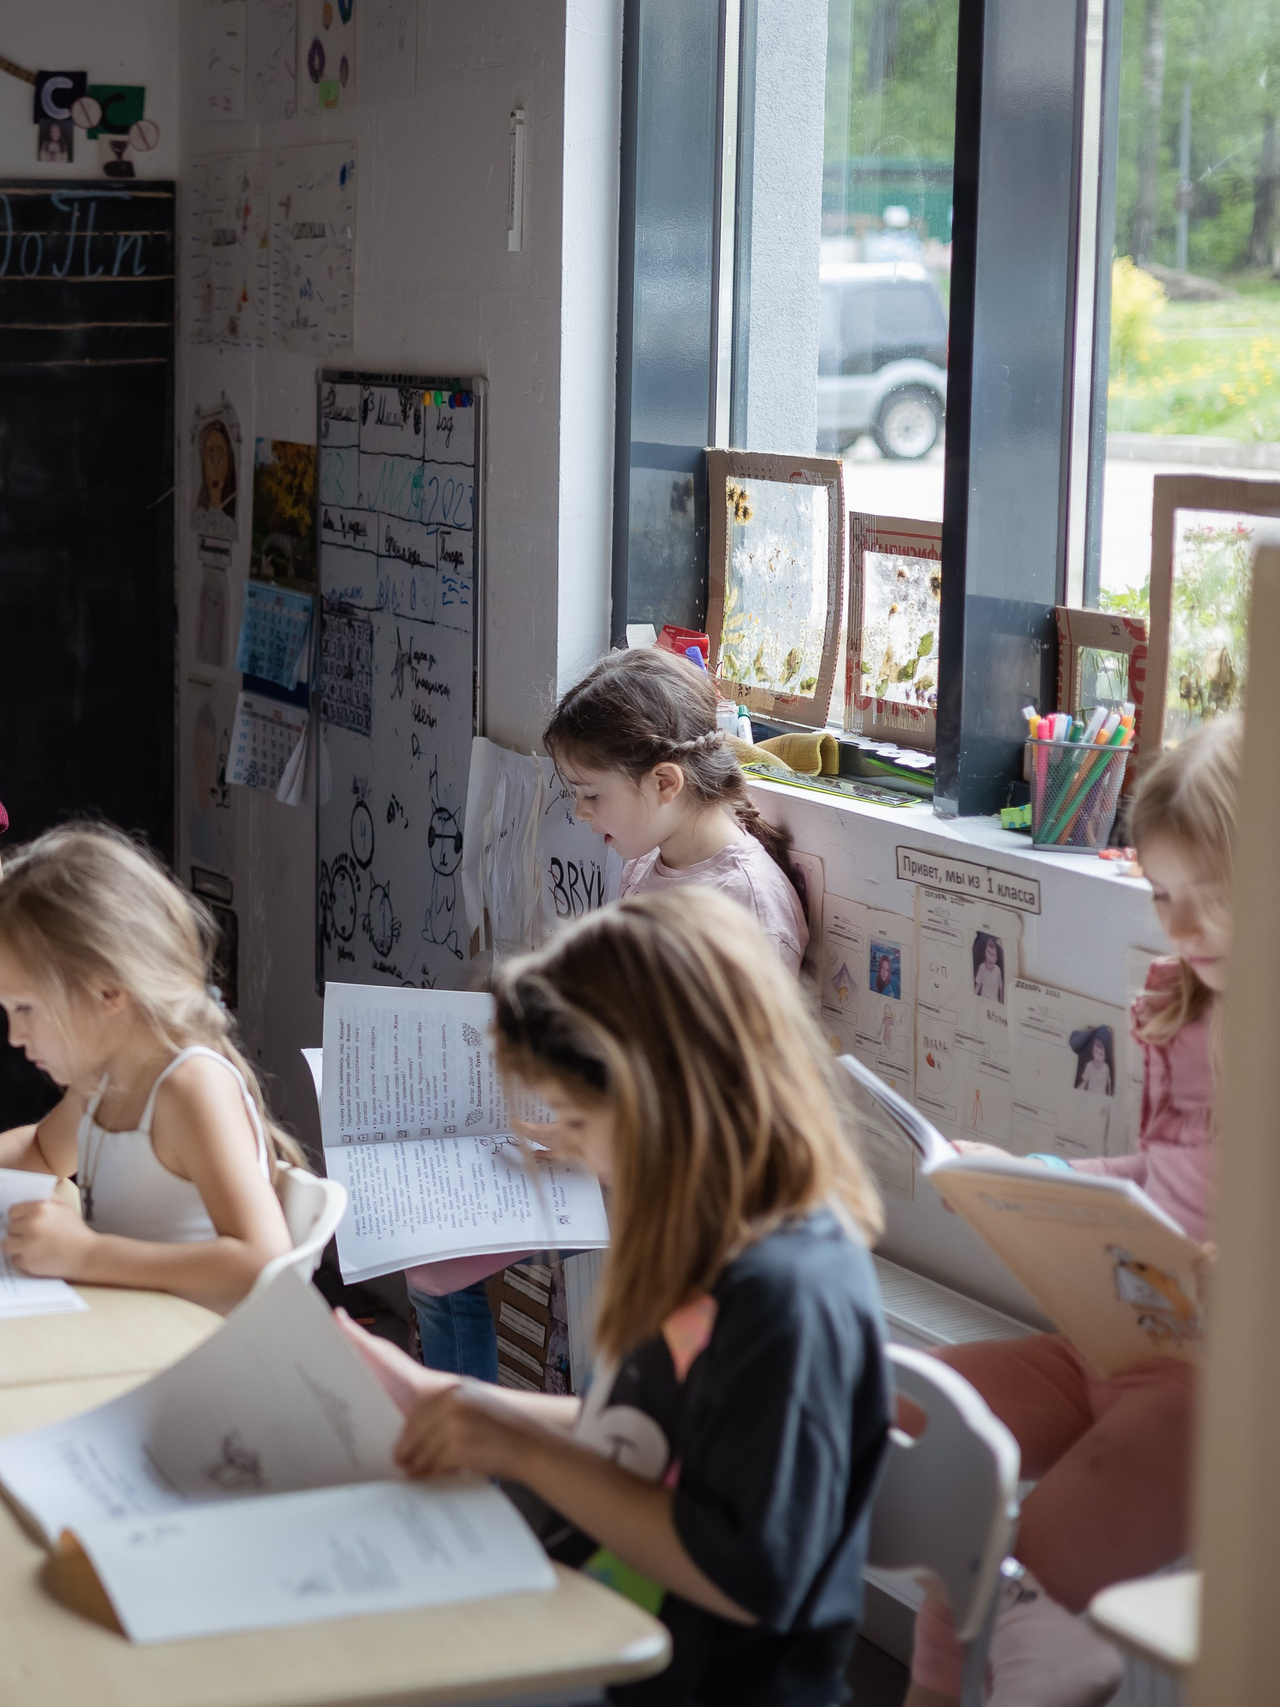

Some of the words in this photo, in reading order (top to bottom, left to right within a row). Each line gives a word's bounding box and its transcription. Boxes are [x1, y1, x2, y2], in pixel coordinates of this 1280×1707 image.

[903, 855, 942, 884] Привет,
[968, 874, 980, 889] из
[988, 877, 994, 894] 1
[997, 883, 1036, 906] класса
